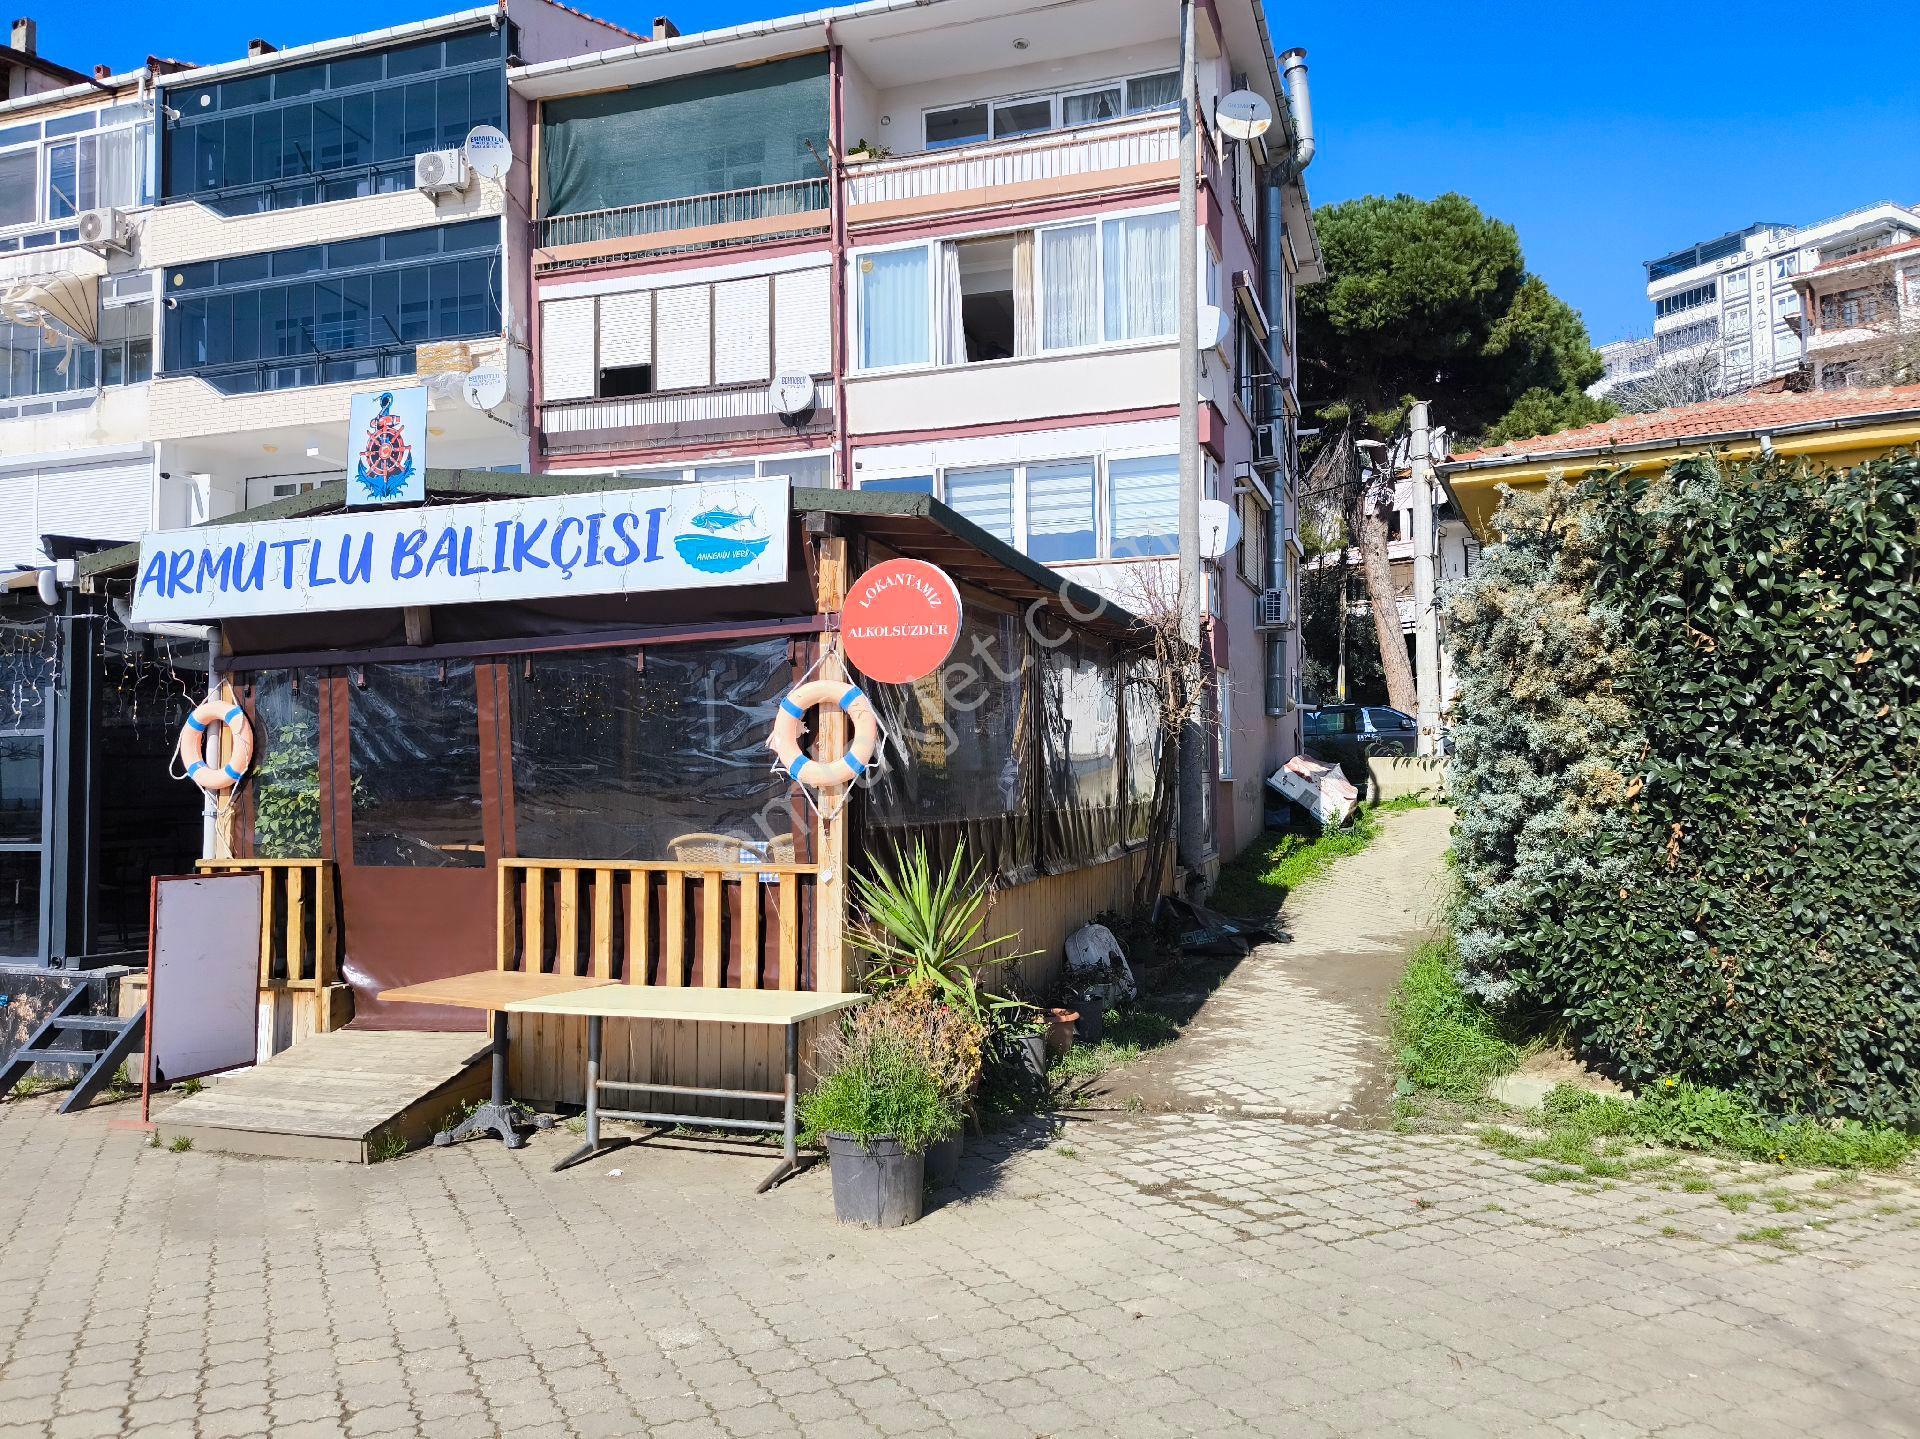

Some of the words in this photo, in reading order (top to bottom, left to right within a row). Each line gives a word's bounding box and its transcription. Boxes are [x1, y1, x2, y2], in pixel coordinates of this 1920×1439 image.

[139, 531, 374, 599] ARMUTLU
[390, 507, 667, 580] BALIKÇISI
[858, 573, 942, 609] LOKANTAMIZ
[847, 623, 949, 638] ALKOLSÜZDÜR
